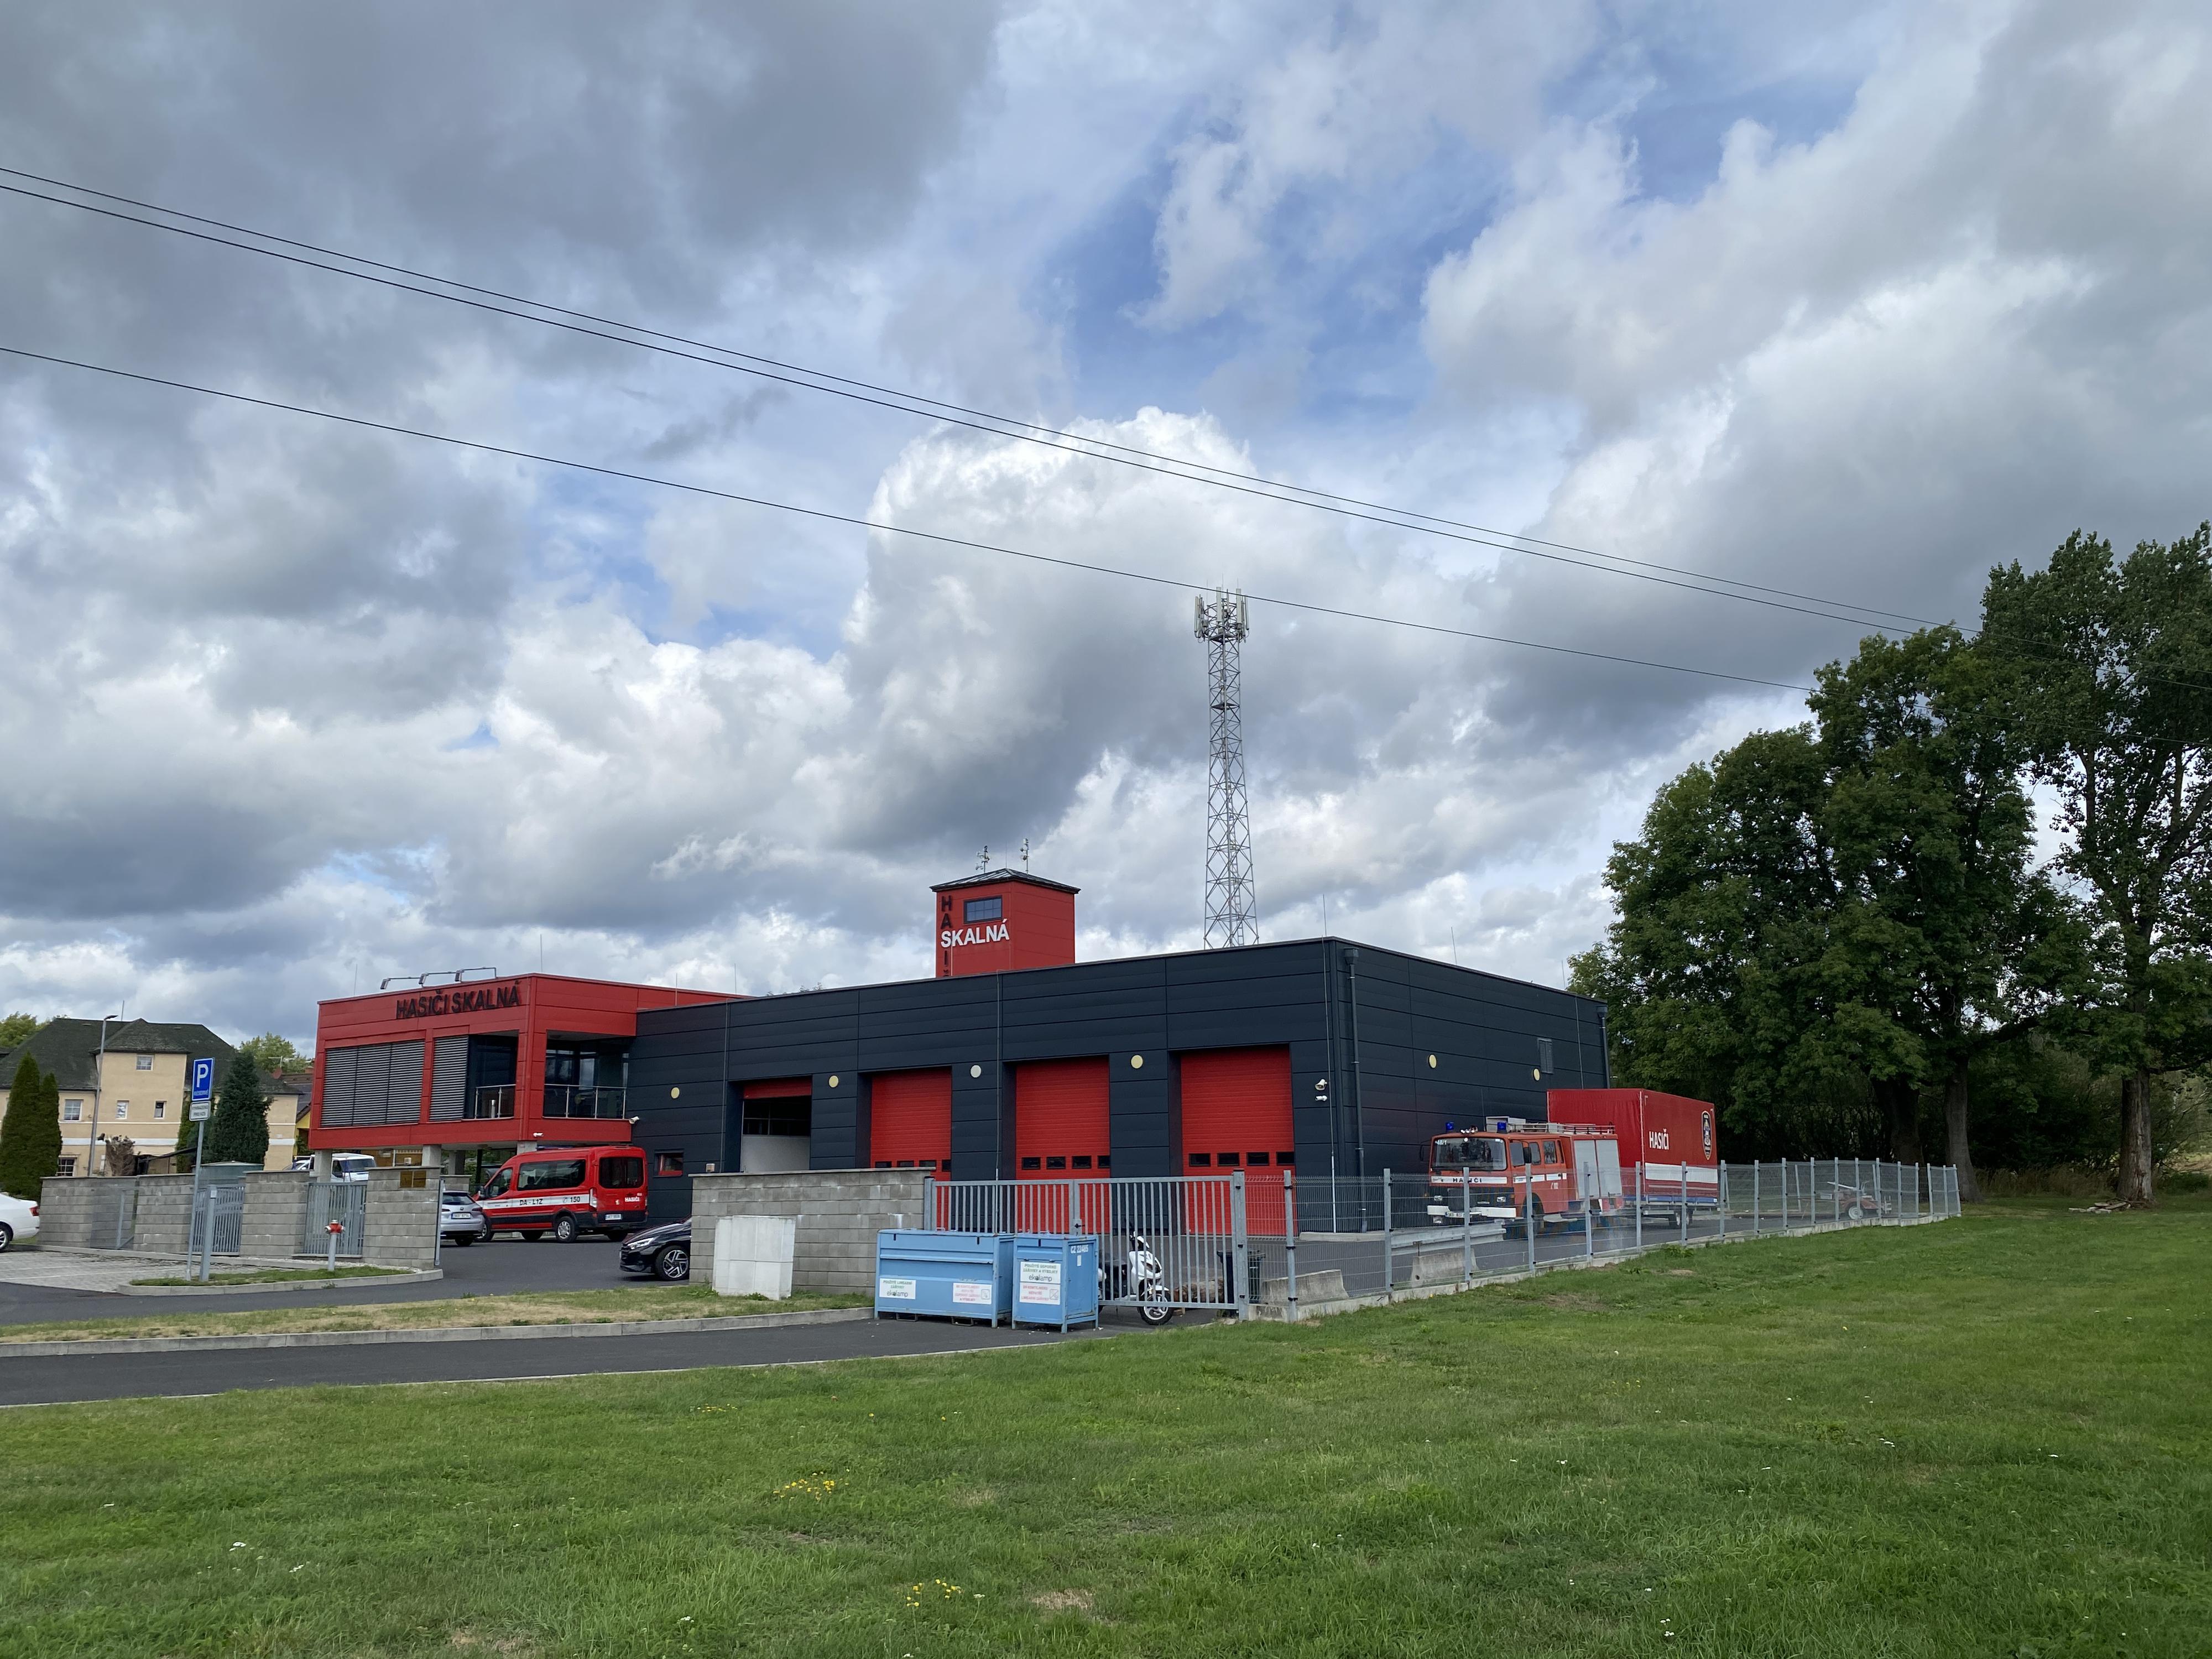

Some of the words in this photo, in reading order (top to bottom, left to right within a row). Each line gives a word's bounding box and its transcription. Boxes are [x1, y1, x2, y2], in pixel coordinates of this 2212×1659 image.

[941, 918, 1010, 947] SKALNÁ
[396, 990, 447, 1019] HASIČI
[451, 980, 521, 1013] SKALNÁ
[196, 1063, 209, 1088] P
[1648, 1128, 1670, 1150] HASIČI
